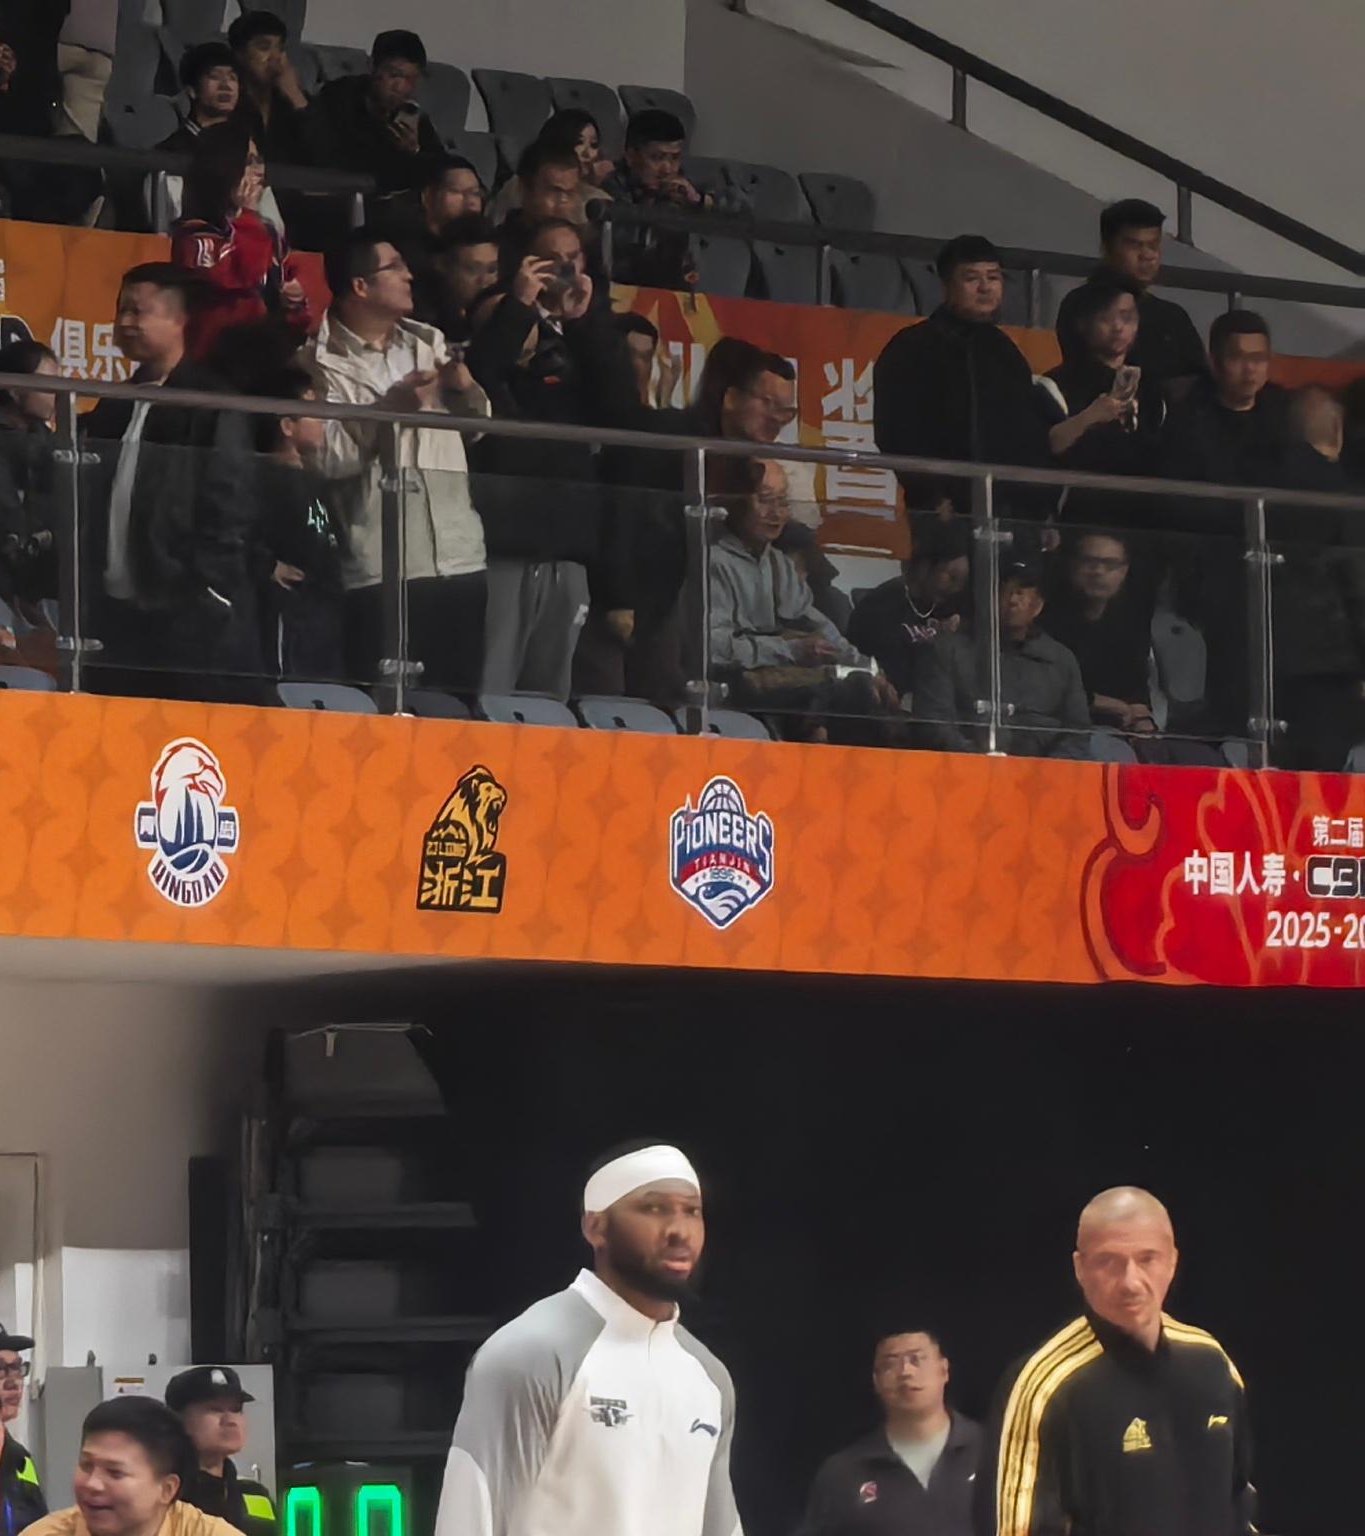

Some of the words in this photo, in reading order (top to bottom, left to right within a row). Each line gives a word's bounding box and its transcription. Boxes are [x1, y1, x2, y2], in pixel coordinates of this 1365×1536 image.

[674, 811, 770, 882] PIONEERS
[1312, 816, 1365, 848] 第二届
[151, 859, 225, 904] QINGDAO
[420, 861, 501, 908] 浙江
[694, 853, 750, 874] TIANJIN
